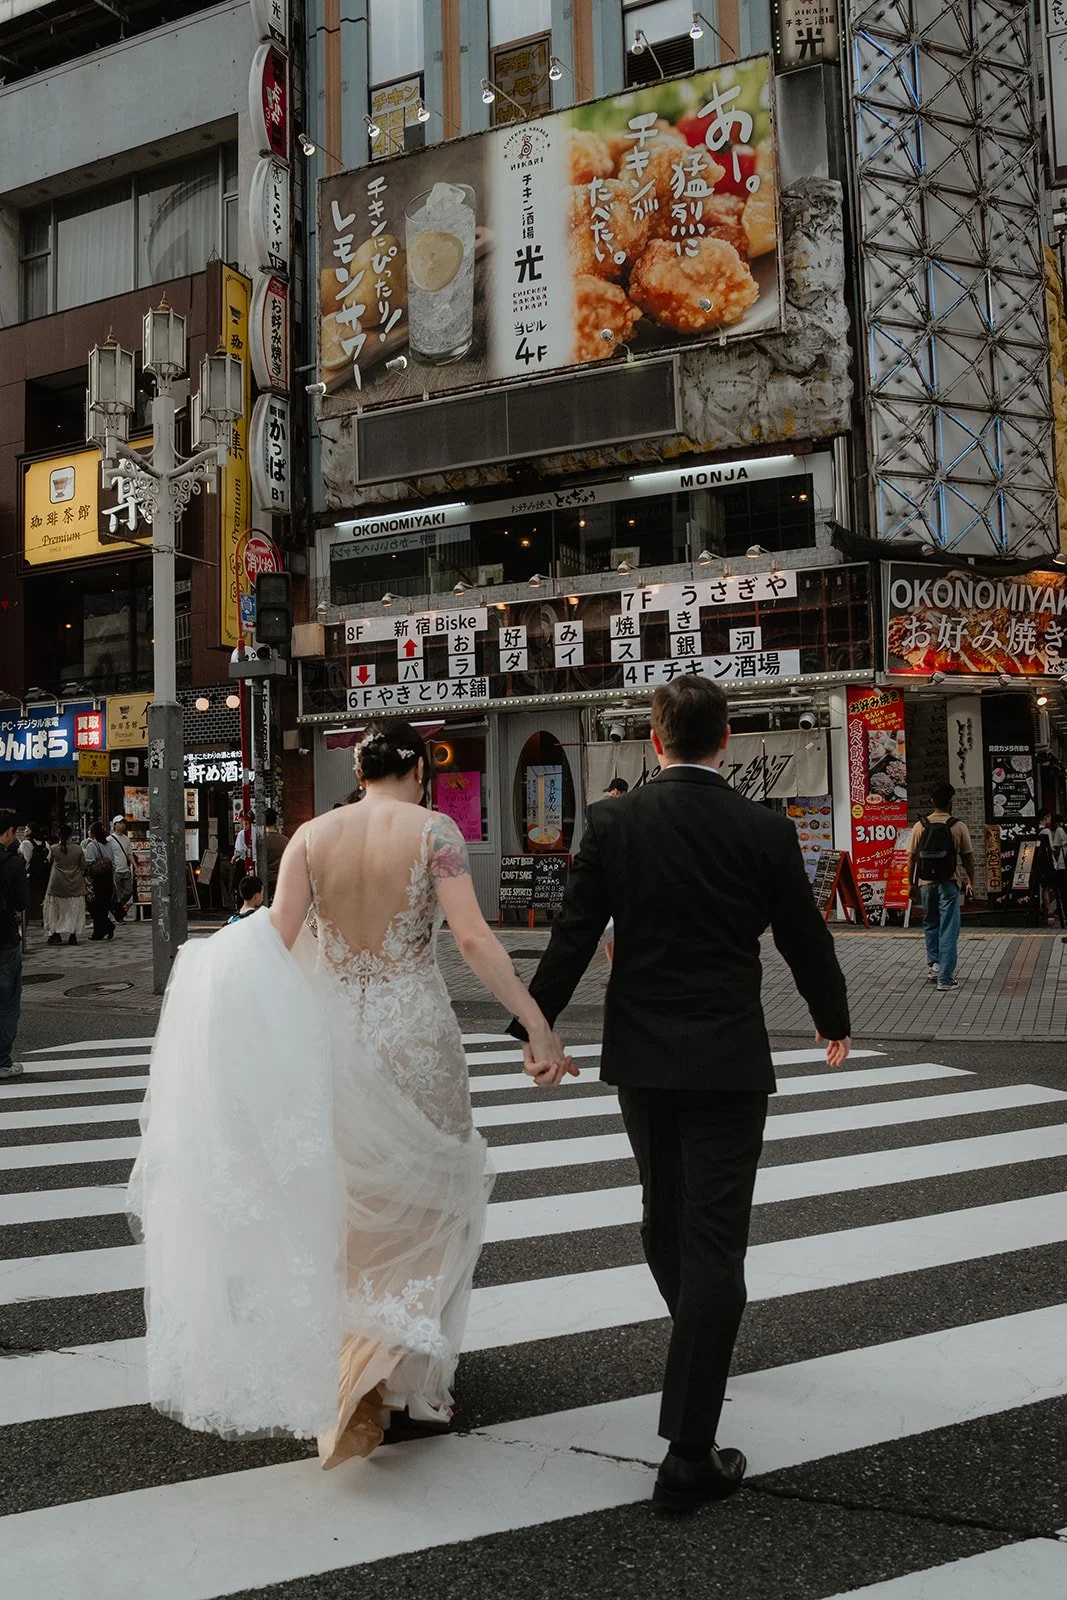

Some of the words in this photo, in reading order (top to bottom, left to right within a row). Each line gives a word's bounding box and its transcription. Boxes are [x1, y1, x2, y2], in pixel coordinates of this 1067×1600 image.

[795, 27, 825, 60] 光
[373, 86, 419, 112] チキン
[624, 112, 659, 222] チキンが
[522, 174, 534, 239] チキン酒場
[670, 153, 715, 258] 猛烈に
[587, 176, 627, 265] たべたい。
[514, 245, 544, 283] 光
[331, 200, 367, 391] レモンサワー
[271, 296, 283, 377] お好み焼き
[514, 320, 547, 336] 当ビル
[515, 337, 547, 366] 4F
[269, 417, 287, 482] かっぱ
[680, 467, 748, 488] MONJA
[271, 487, 285, 503] B1
[30, 504, 91, 530] 珈琲茶館
[352, 513, 446, 537] OKONOMIYAKI
[41, 531, 81, 547] Premium
[623, 592, 652, 611] 7F
[681, 575, 787, 606] うさぎや
[347, 626, 364, 641] 8F
[902, 614, 1067, 657] お好み焼き
[849, 690, 900, 714] お好み焼き
[77, 716, 99, 730] 買取
[78, 731, 99, 746] 販売
[849, 718, 866, 806] 食べ飲み放題
[855, 825, 897, 844] 3,180
[501, 857, 520, 866] CRAFT
[543, 864, 559, 872] BAR
[501, 871, 518, 880] CRAFT
